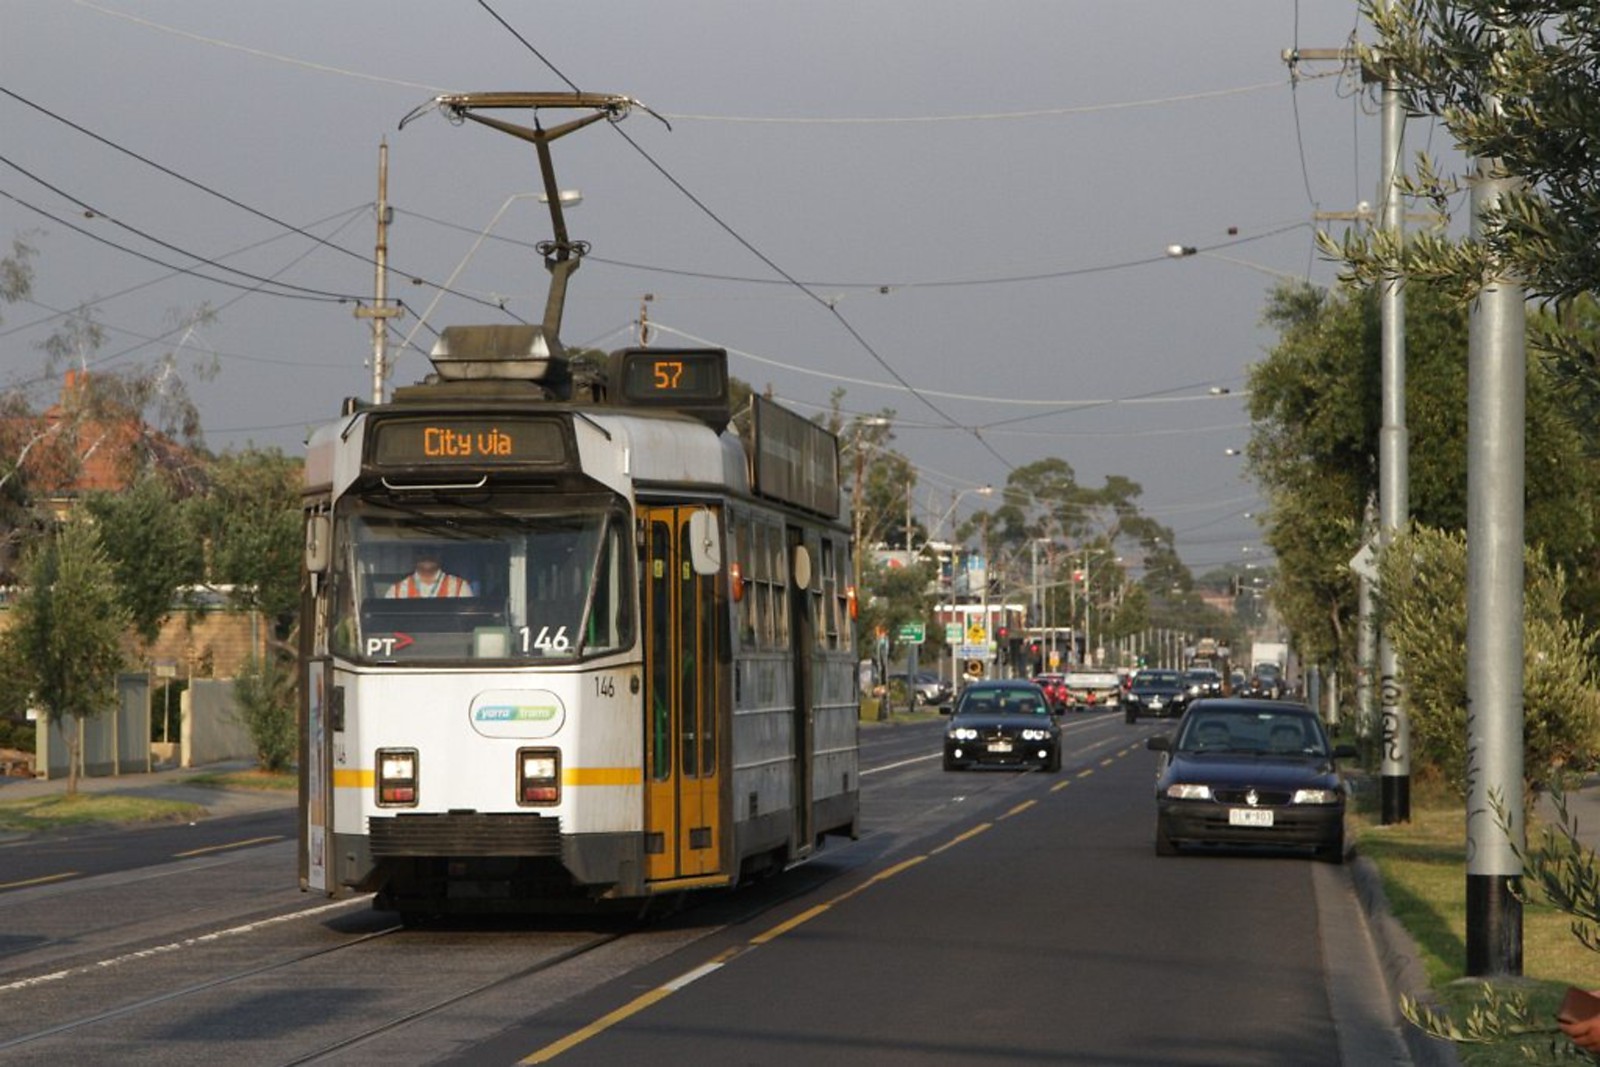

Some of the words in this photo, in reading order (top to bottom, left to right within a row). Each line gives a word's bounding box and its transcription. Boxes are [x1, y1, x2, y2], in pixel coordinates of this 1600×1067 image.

[654, 361, 682, 388] 57
[424, 427, 470, 455] City
[477, 427, 511, 455] via
[366, 638, 396, 656] PT
[519, 626, 569, 652] 146
[594, 676, 615, 698] 146
